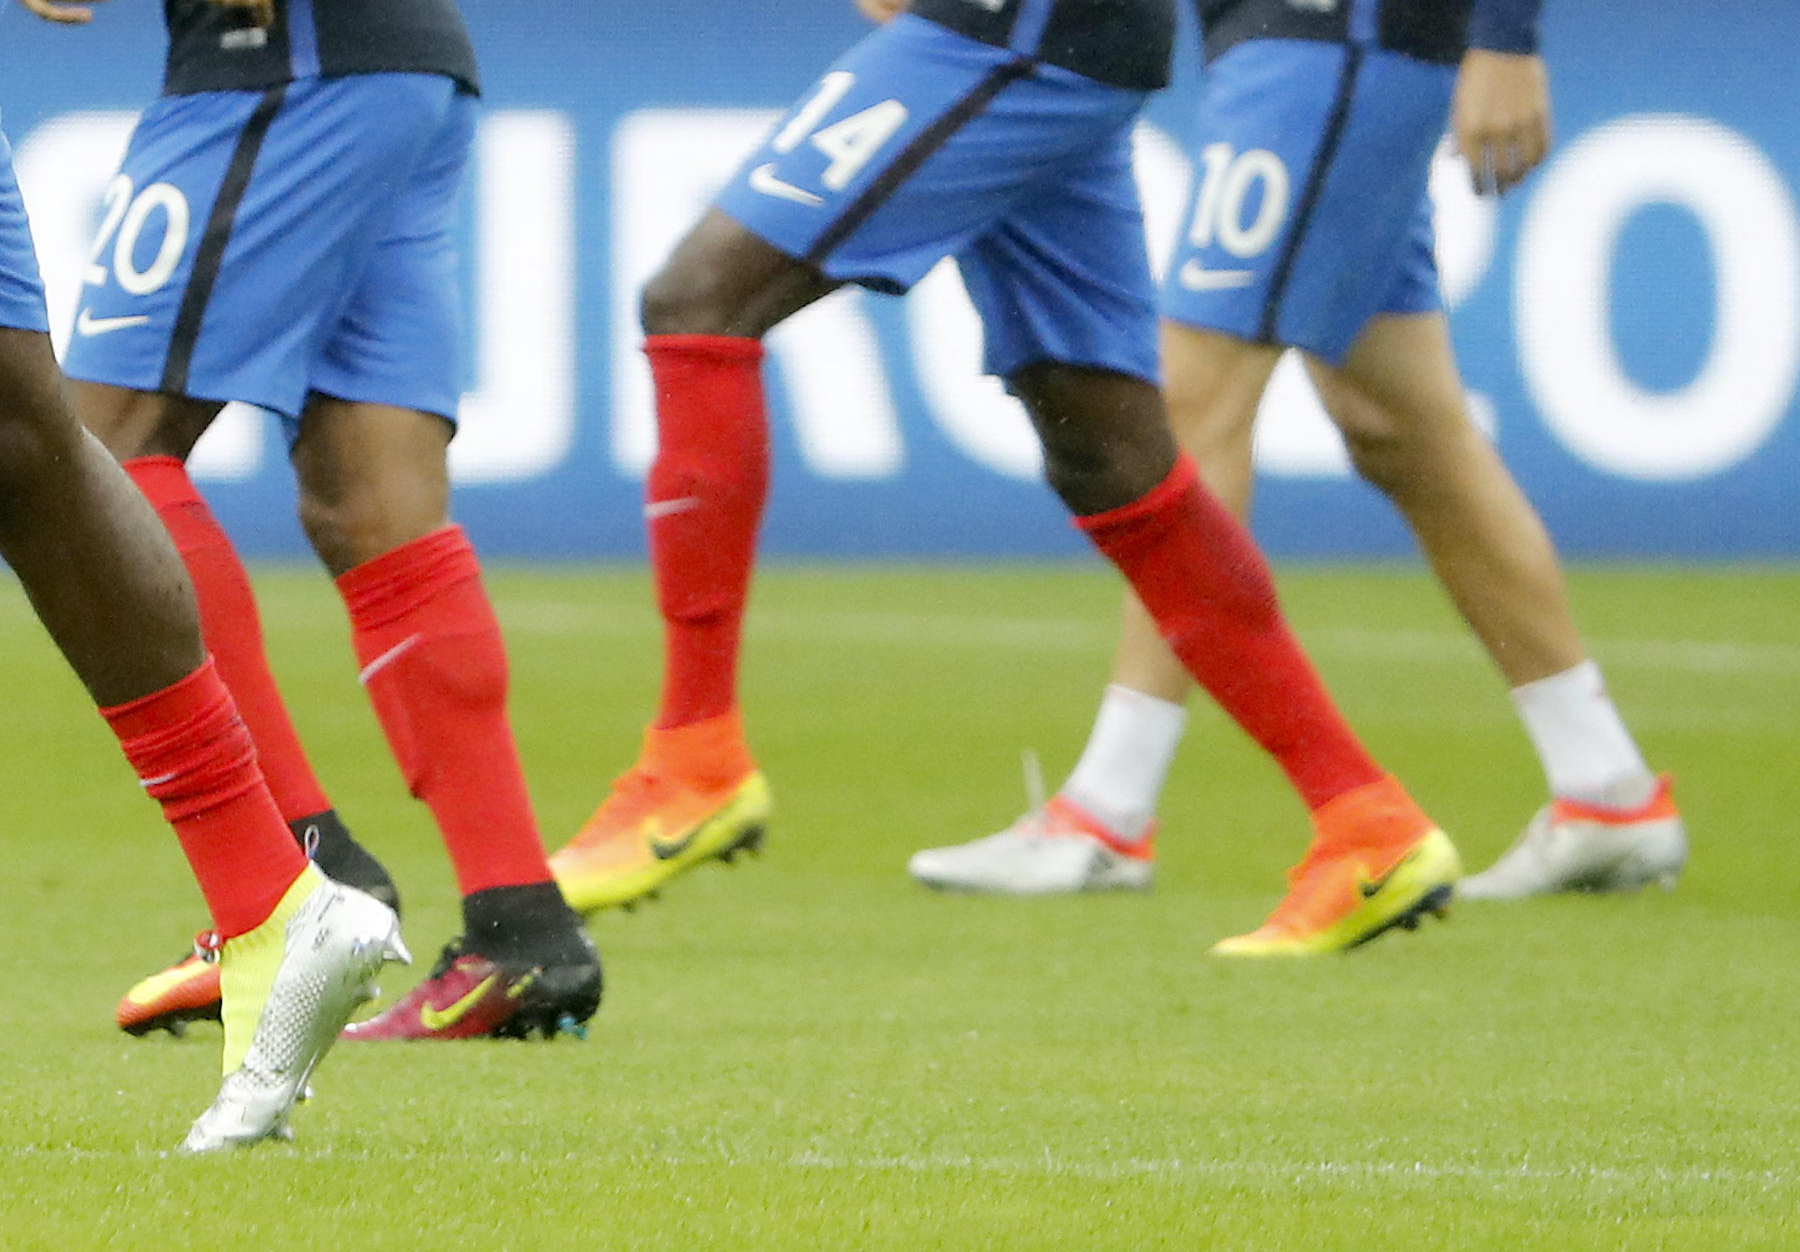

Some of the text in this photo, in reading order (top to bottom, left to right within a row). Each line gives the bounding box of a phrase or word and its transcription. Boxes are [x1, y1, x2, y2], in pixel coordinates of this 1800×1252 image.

[773, 70, 908, 191] 14
[80, 172, 191, 295] 20
[1189, 141, 1290, 258] 10
